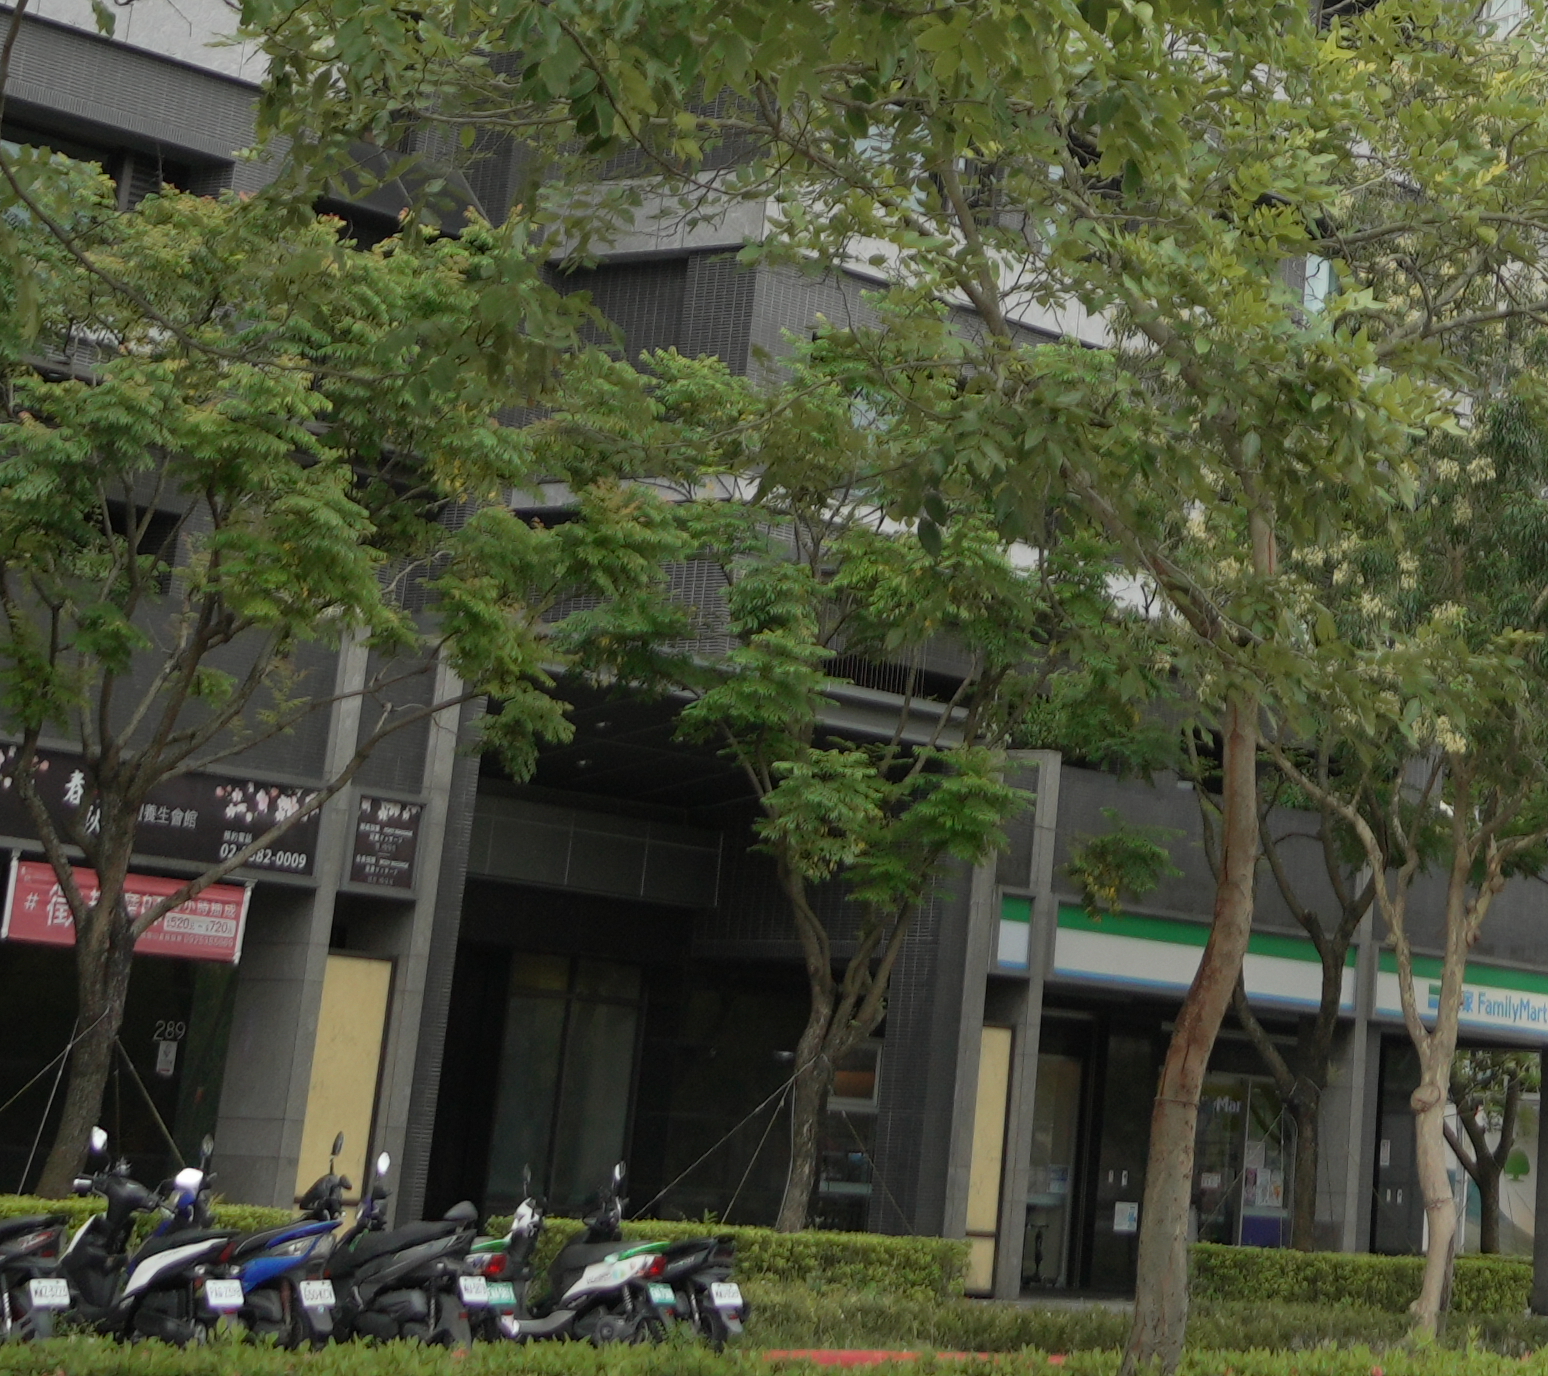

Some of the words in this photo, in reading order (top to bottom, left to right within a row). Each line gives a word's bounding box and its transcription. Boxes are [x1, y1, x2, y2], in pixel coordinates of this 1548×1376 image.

[138, 802, 199, 830] 養生會館
[1478, 991, 1548, 1024] FamilyMart
[153, 1020, 186, 1041] 289
